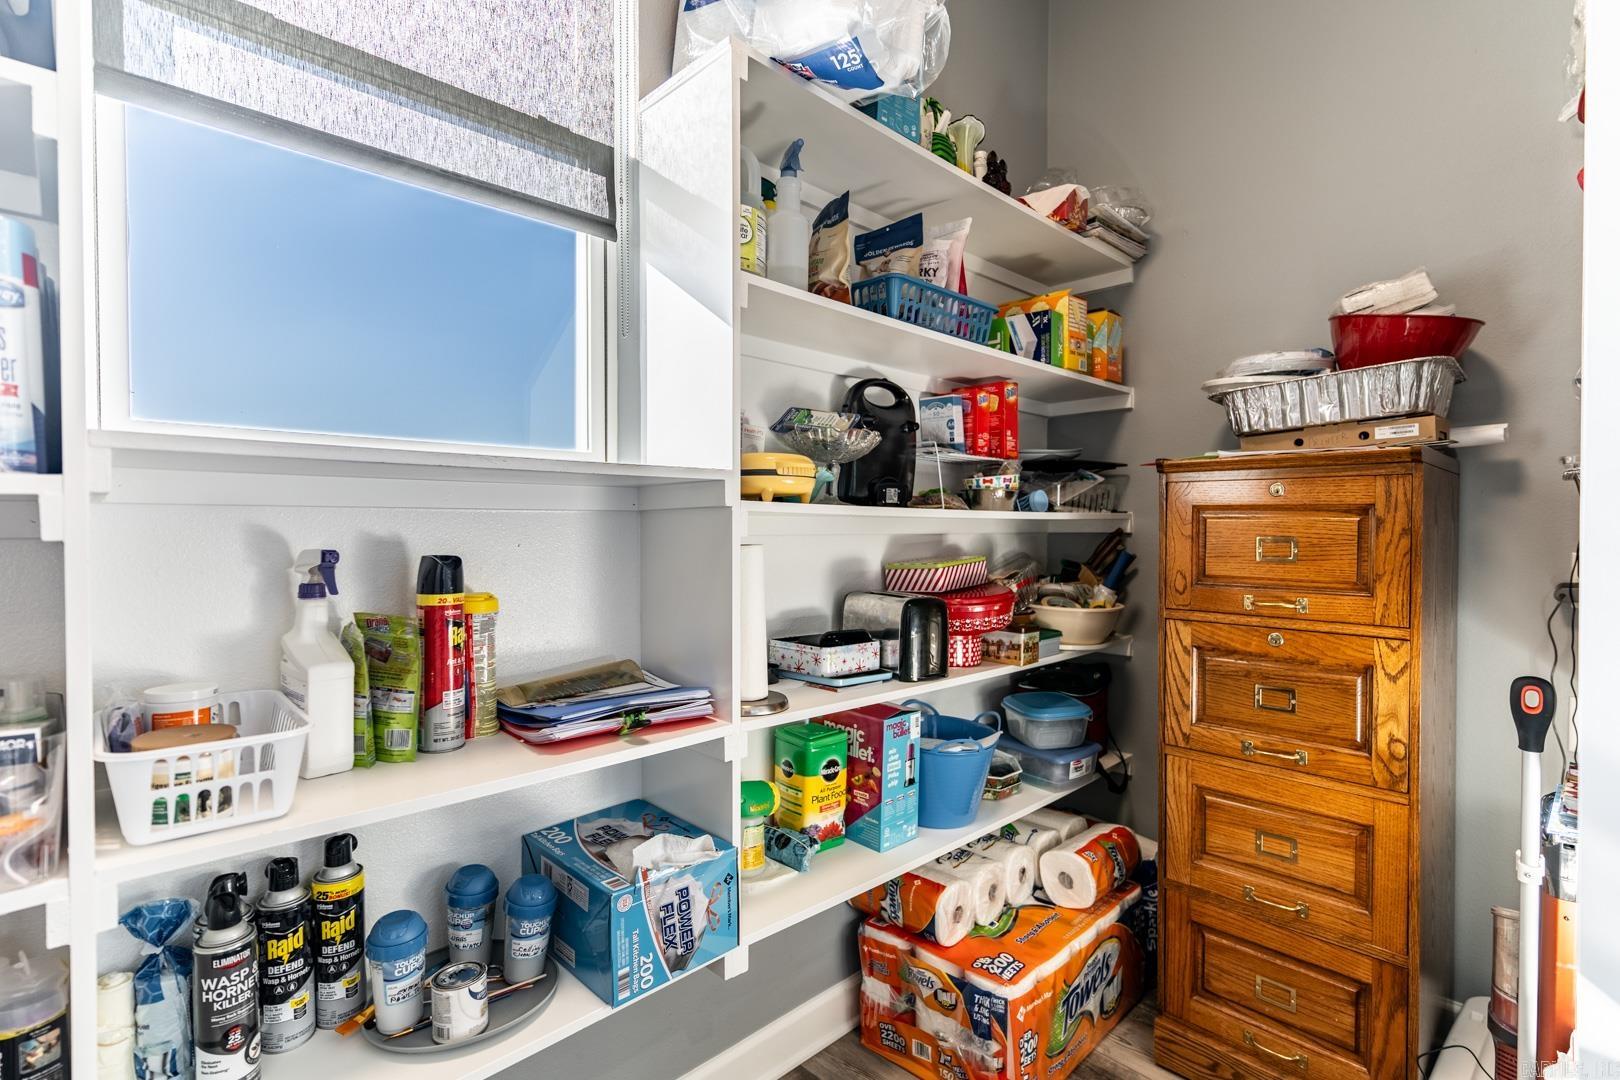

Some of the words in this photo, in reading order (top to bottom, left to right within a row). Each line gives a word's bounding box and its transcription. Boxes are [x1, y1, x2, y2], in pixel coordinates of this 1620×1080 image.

[830, 49, 860, 71] 125
[847, 63, 864, 73] COUNT
[920, 267, 940, 278] RKY
[449, 626, 466, 646] Ra
[886, 719, 907, 732] magic
[811, 793, 830, 805] Plant
[540, 826, 573, 844] 200
[321, 908, 356, 940] Raid
[660, 902, 678, 951] FLEX
[676, 886, 695, 956] POWER
[267, 926, 304, 960] Raid
[321, 940, 355, 954] DEFEND
[212, 949, 251, 969] ELIMINATOR
[267, 958, 304, 975] DEFEND
[317, 955, 332, 964] Wasp
[201, 967, 250, 991] WASP
[640, 952, 654, 990] 200
[263, 977, 279, 985] Wasp
[1061, 952, 1112, 1040] Towels
[880, 1030, 906, 1047] 2200
[882, 1038, 906, 1054] SHEETS
